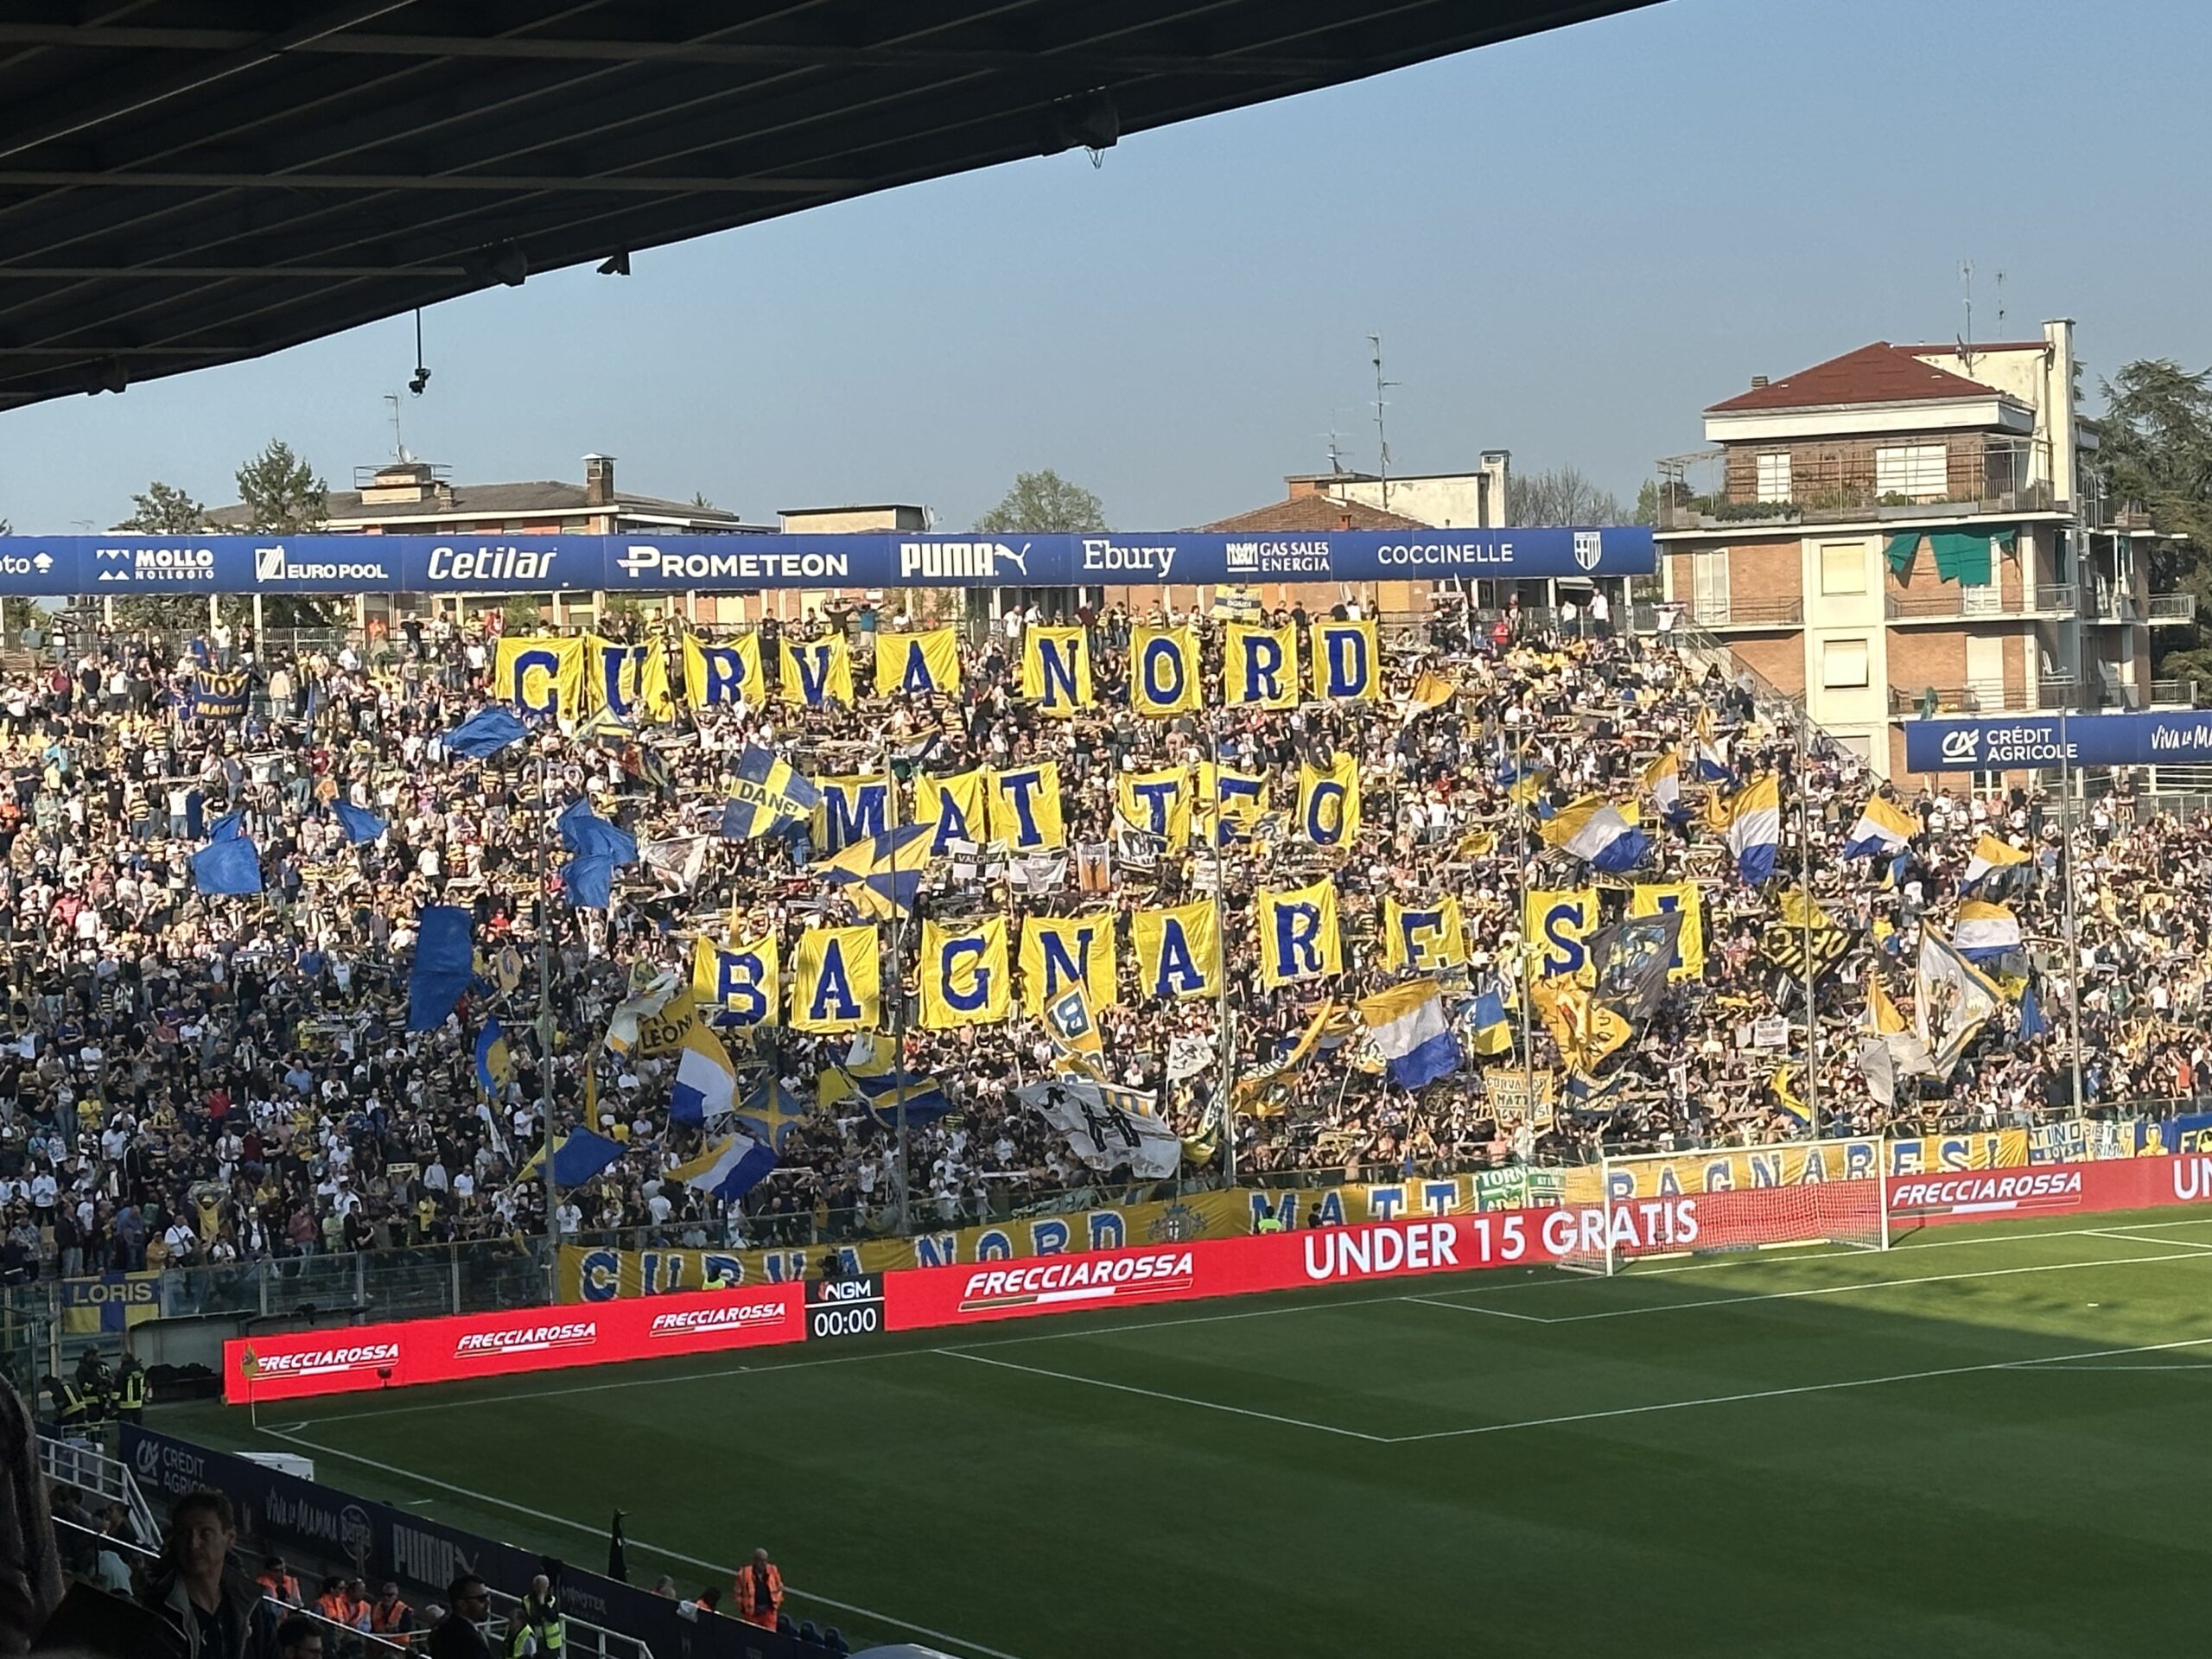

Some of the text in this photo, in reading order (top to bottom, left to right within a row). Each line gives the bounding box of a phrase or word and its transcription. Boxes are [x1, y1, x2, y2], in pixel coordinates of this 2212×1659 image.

[135, 550, 214, 567] MOLLO
[428, 546, 558, 580] Cetilar
[626, 545, 849, 578] PROMETEON
[900, 543, 999, 578] PUMA
[1082, 539, 1176, 578] Ebury
[1260, 542, 1329, 556] GAS SALES
[1377, 543, 1514, 564] COCCINELLE
[1262, 557, 1331, 571] ENERGIA
[513, 629, 1368, 715] CURVA NORD
[1986, 726, 2052, 745] CRÉDIT
[1986, 744, 2078, 762] AGRICOLE
[714, 896, 1685, 1027] BAGNARESI
[2031, 1123, 2080, 1147] TINO
[2044, 1142, 2074, 1158] BOYS
[1891, 1171, 2082, 1207] FRECCIAROSSA
[1249, 1179, 1479, 1235] MATT
[1303, 1198, 1699, 1280] UNDER 15 GRATIS
[824, 1279, 872, 1300] NGM
[963, 1252, 1193, 1298] FRECCIAROSSA
[73, 1282, 152, 1303] LORIS
[652, 1302, 786, 1330] FRECCIAROSSA
[814, 1307, 877, 1337] 00:00
[456, 1322, 597, 1351] FRECCIAROSSA
[257, 1343, 399, 1372] FRECCIAROSSA
[162, 1446, 205, 1479] CRÉDIT
[392, 1522, 454, 1591] PUMA
